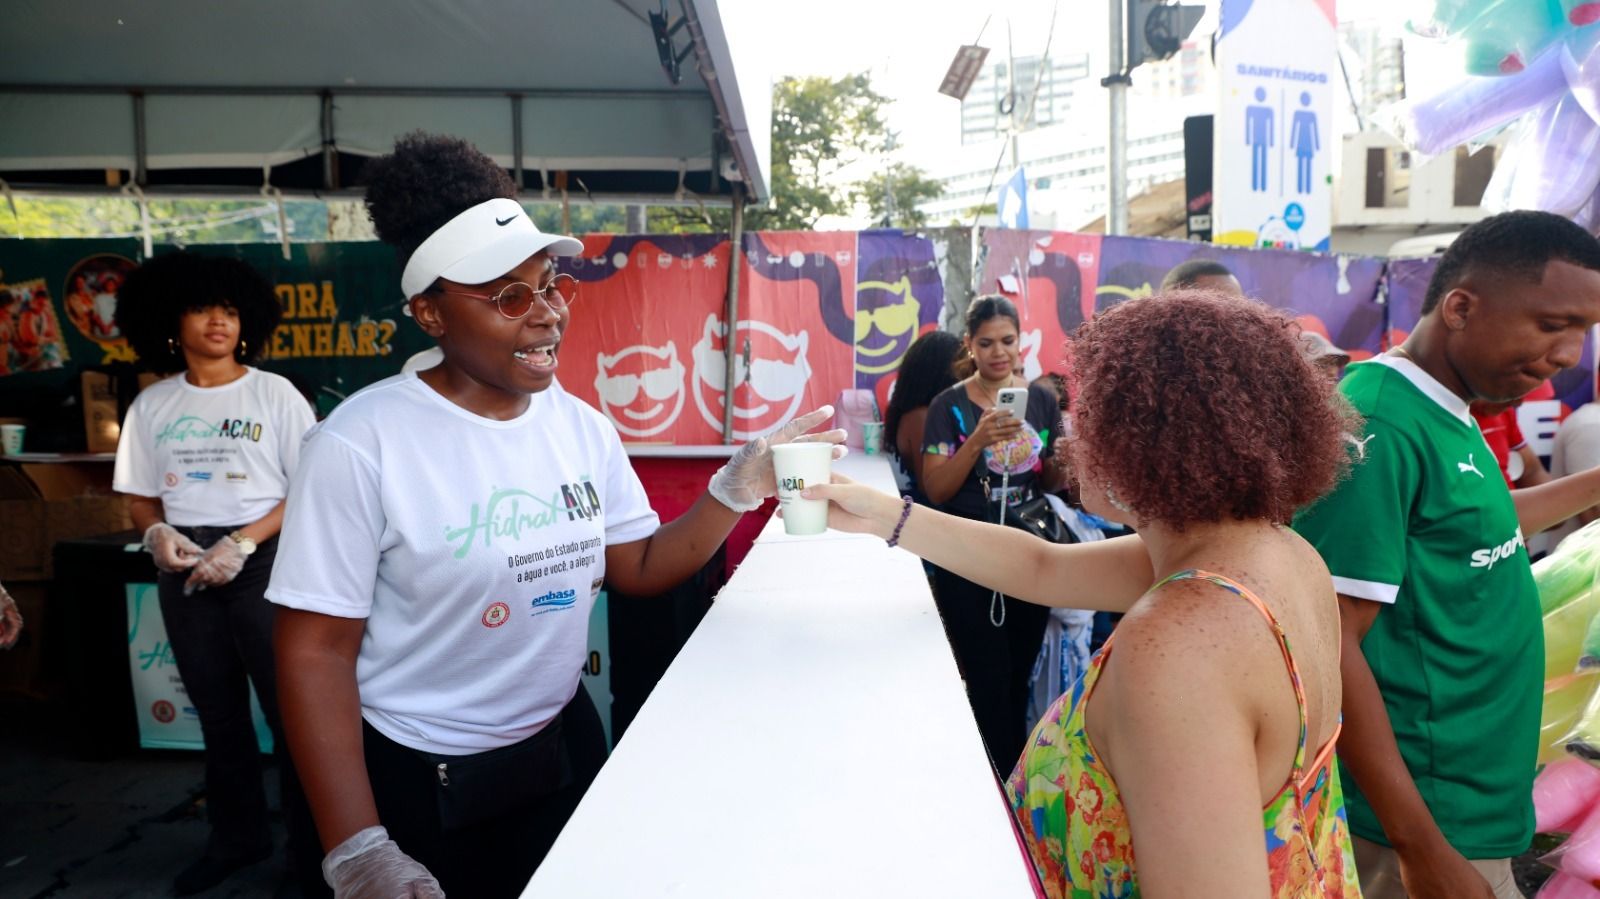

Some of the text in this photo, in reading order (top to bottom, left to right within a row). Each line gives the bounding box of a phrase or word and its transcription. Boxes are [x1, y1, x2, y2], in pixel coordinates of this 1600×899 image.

[274, 280, 338, 319] ORA
[264, 320, 394, 359] ENHAR?
[777, 476, 805, 492] AÇÃO
[514, 550, 545, 567] Governo
[545, 547, 555, 559] do
[555, 541, 579, 557] Estado
[517, 573, 522, 583] a
[524, 568, 542, 583] água
[544, 566, 549, 577] e
[569, 560, 575, 570] a
[532, 588, 576, 607] embasa
